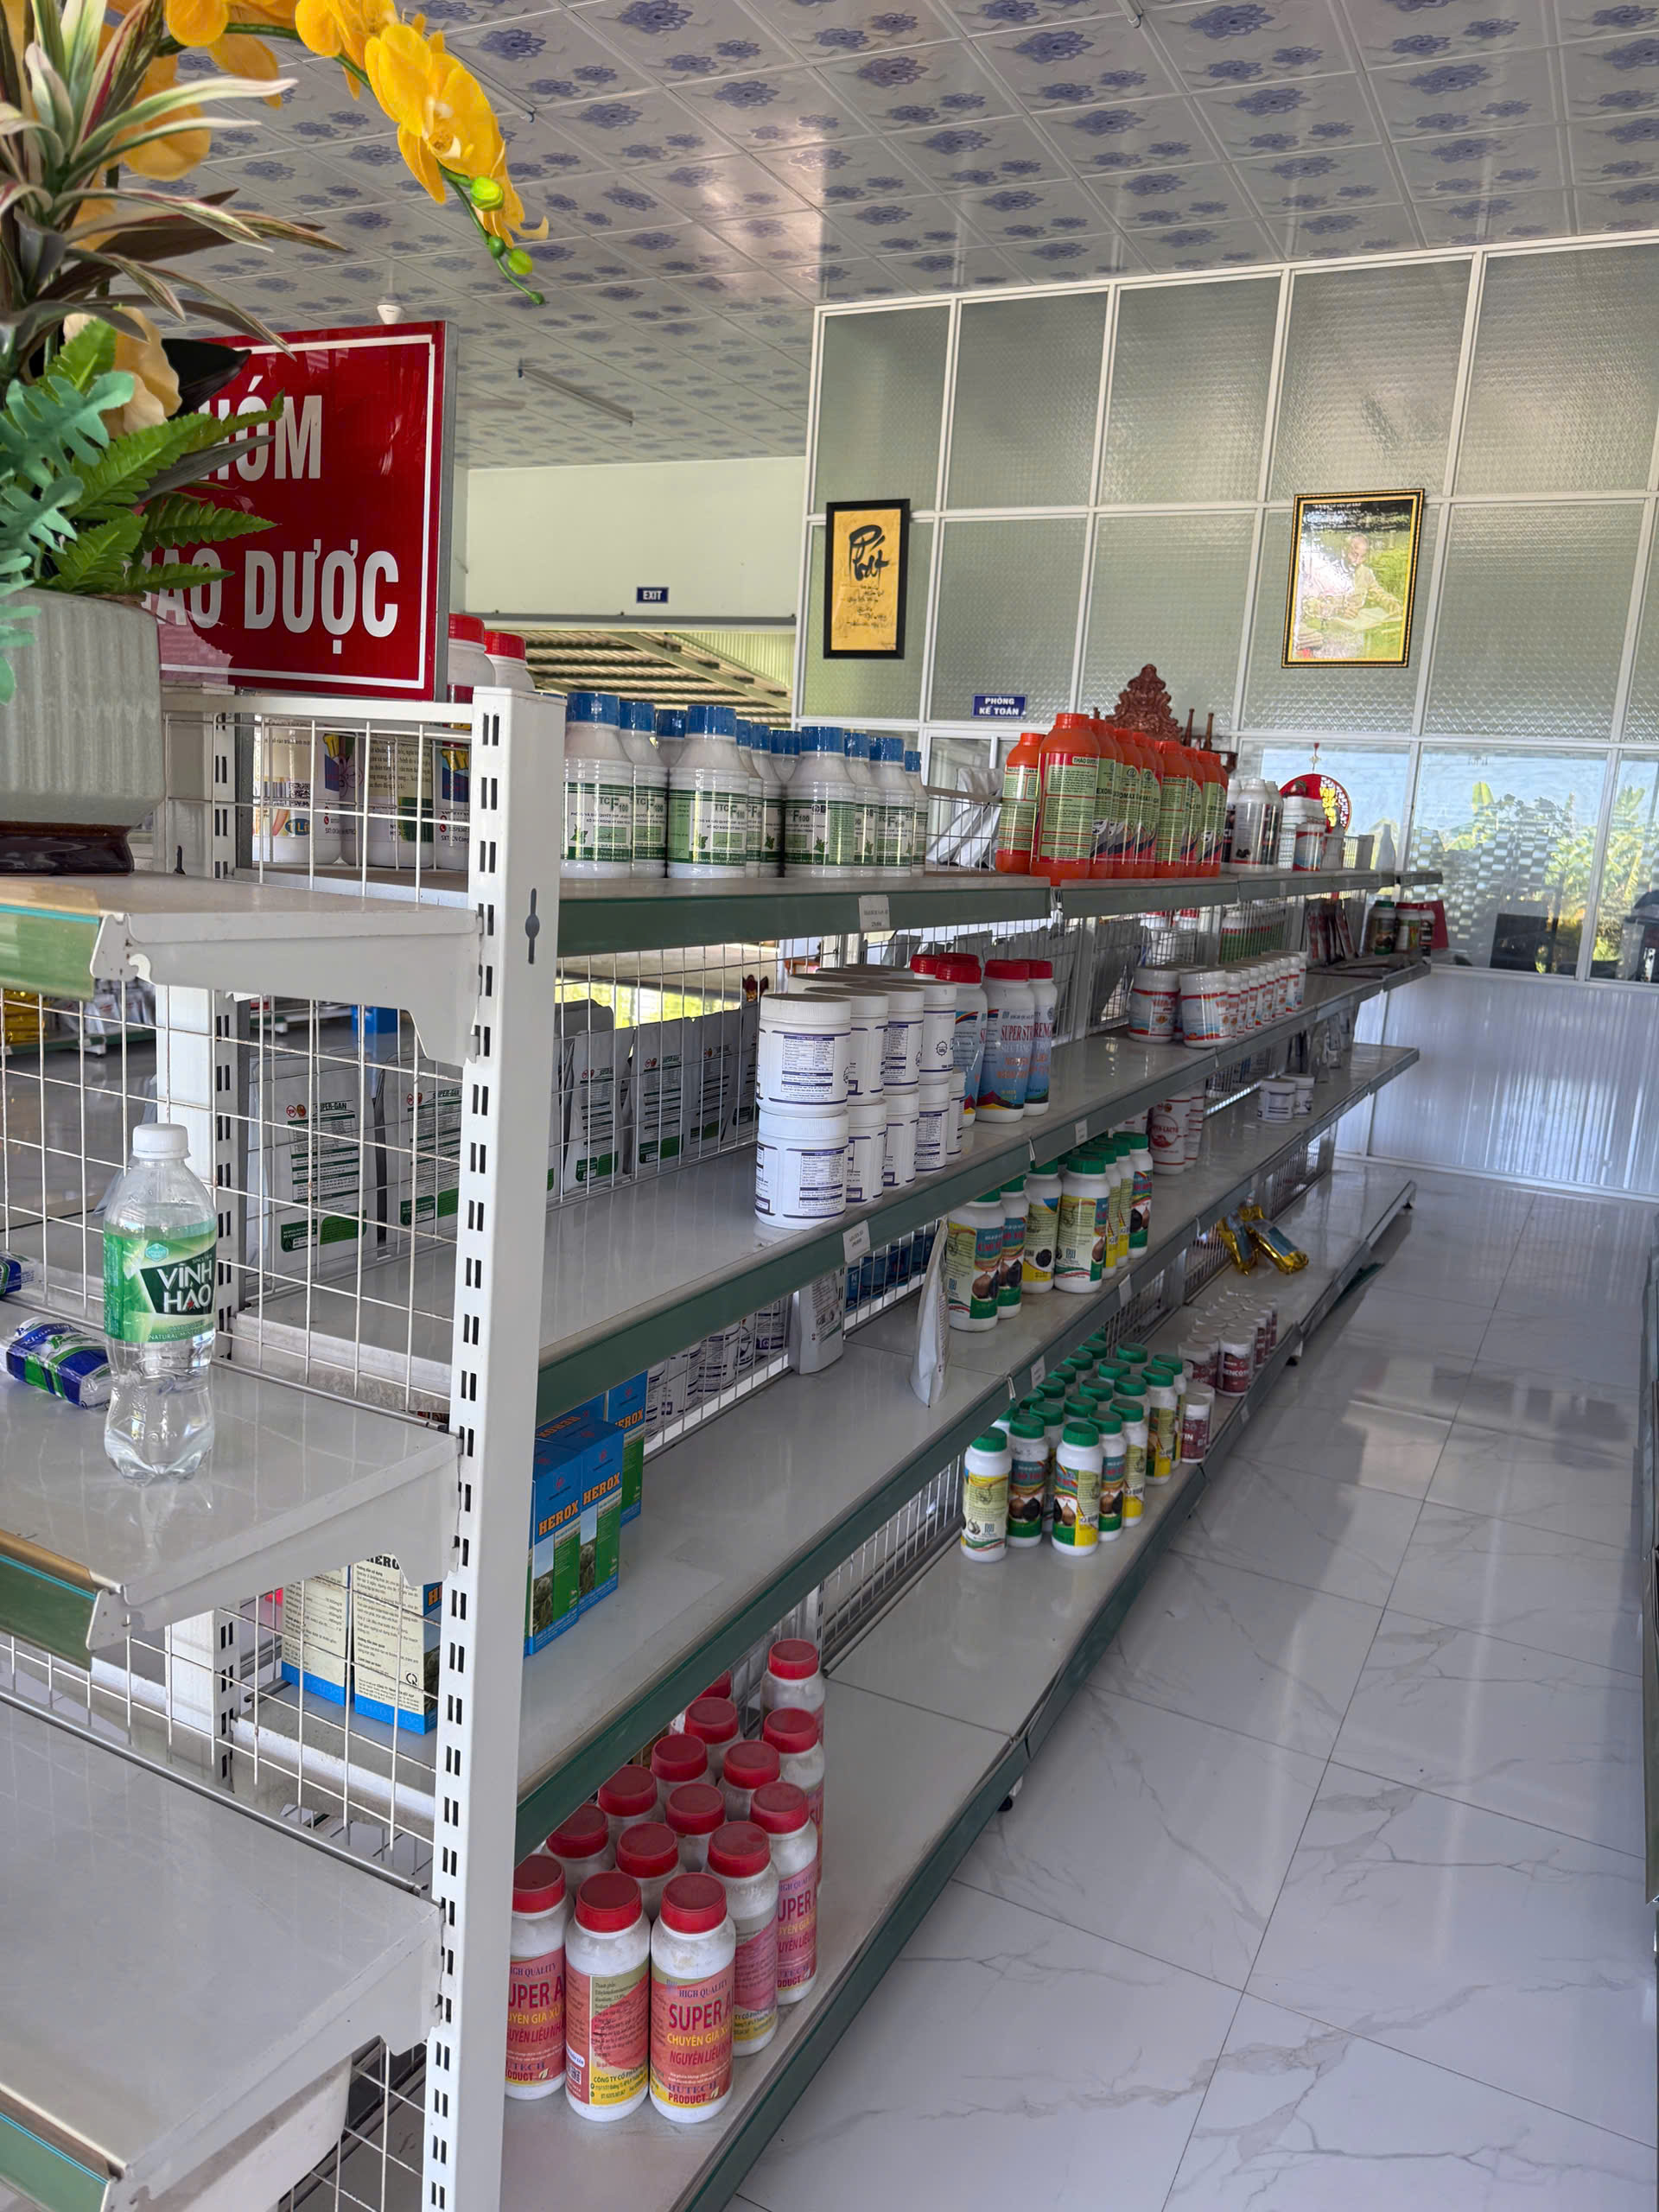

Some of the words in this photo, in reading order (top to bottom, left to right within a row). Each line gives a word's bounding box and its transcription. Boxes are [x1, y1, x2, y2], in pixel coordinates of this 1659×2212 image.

[197, 375, 323, 482] HÓM
[245, 538, 399, 654] DƯỢC
[642, 590, 663, 601] EXIT
[984, 696, 1015, 705] PHÒNG
[978, 704, 992, 715] KẾ
[993, 706, 1020, 715] TOÁN
[1001, 1025, 1021, 1042] SUPER
[156, 1259, 213, 1290] VĨNH
[615, 1408, 644, 1428] EROX
[582, 1471, 620, 1505] HEROX
[538, 1499, 579, 1536] HEROX
[778, 1890, 812, 1922] UPER
[779, 1937, 798, 1953] UYÊN
[510, 1967, 522, 1976] IGH
[524, 1962, 556, 1978] QUALITY
[679, 1989, 698, 1999] HIGH
[700, 1979, 728, 1998] QUALITY
[778, 1976, 801, 1987] ODUCT
[508, 1981, 550, 2009] UPER
[531, 2012, 547, 2024] GIA
[669, 1999, 722, 2031] SUPER
[508, 2028, 531, 2043] UYÊN
[667, 2031, 703, 2047] CHUYÊN
[704, 2031, 719, 2044] GIA
[670, 2050, 704, 2068] NGUYÊN
[507, 2072, 534, 2082] ODUCT
[668, 2079, 717, 2094] HUTECH
[668, 2093, 707, 2105] PRODUCT
